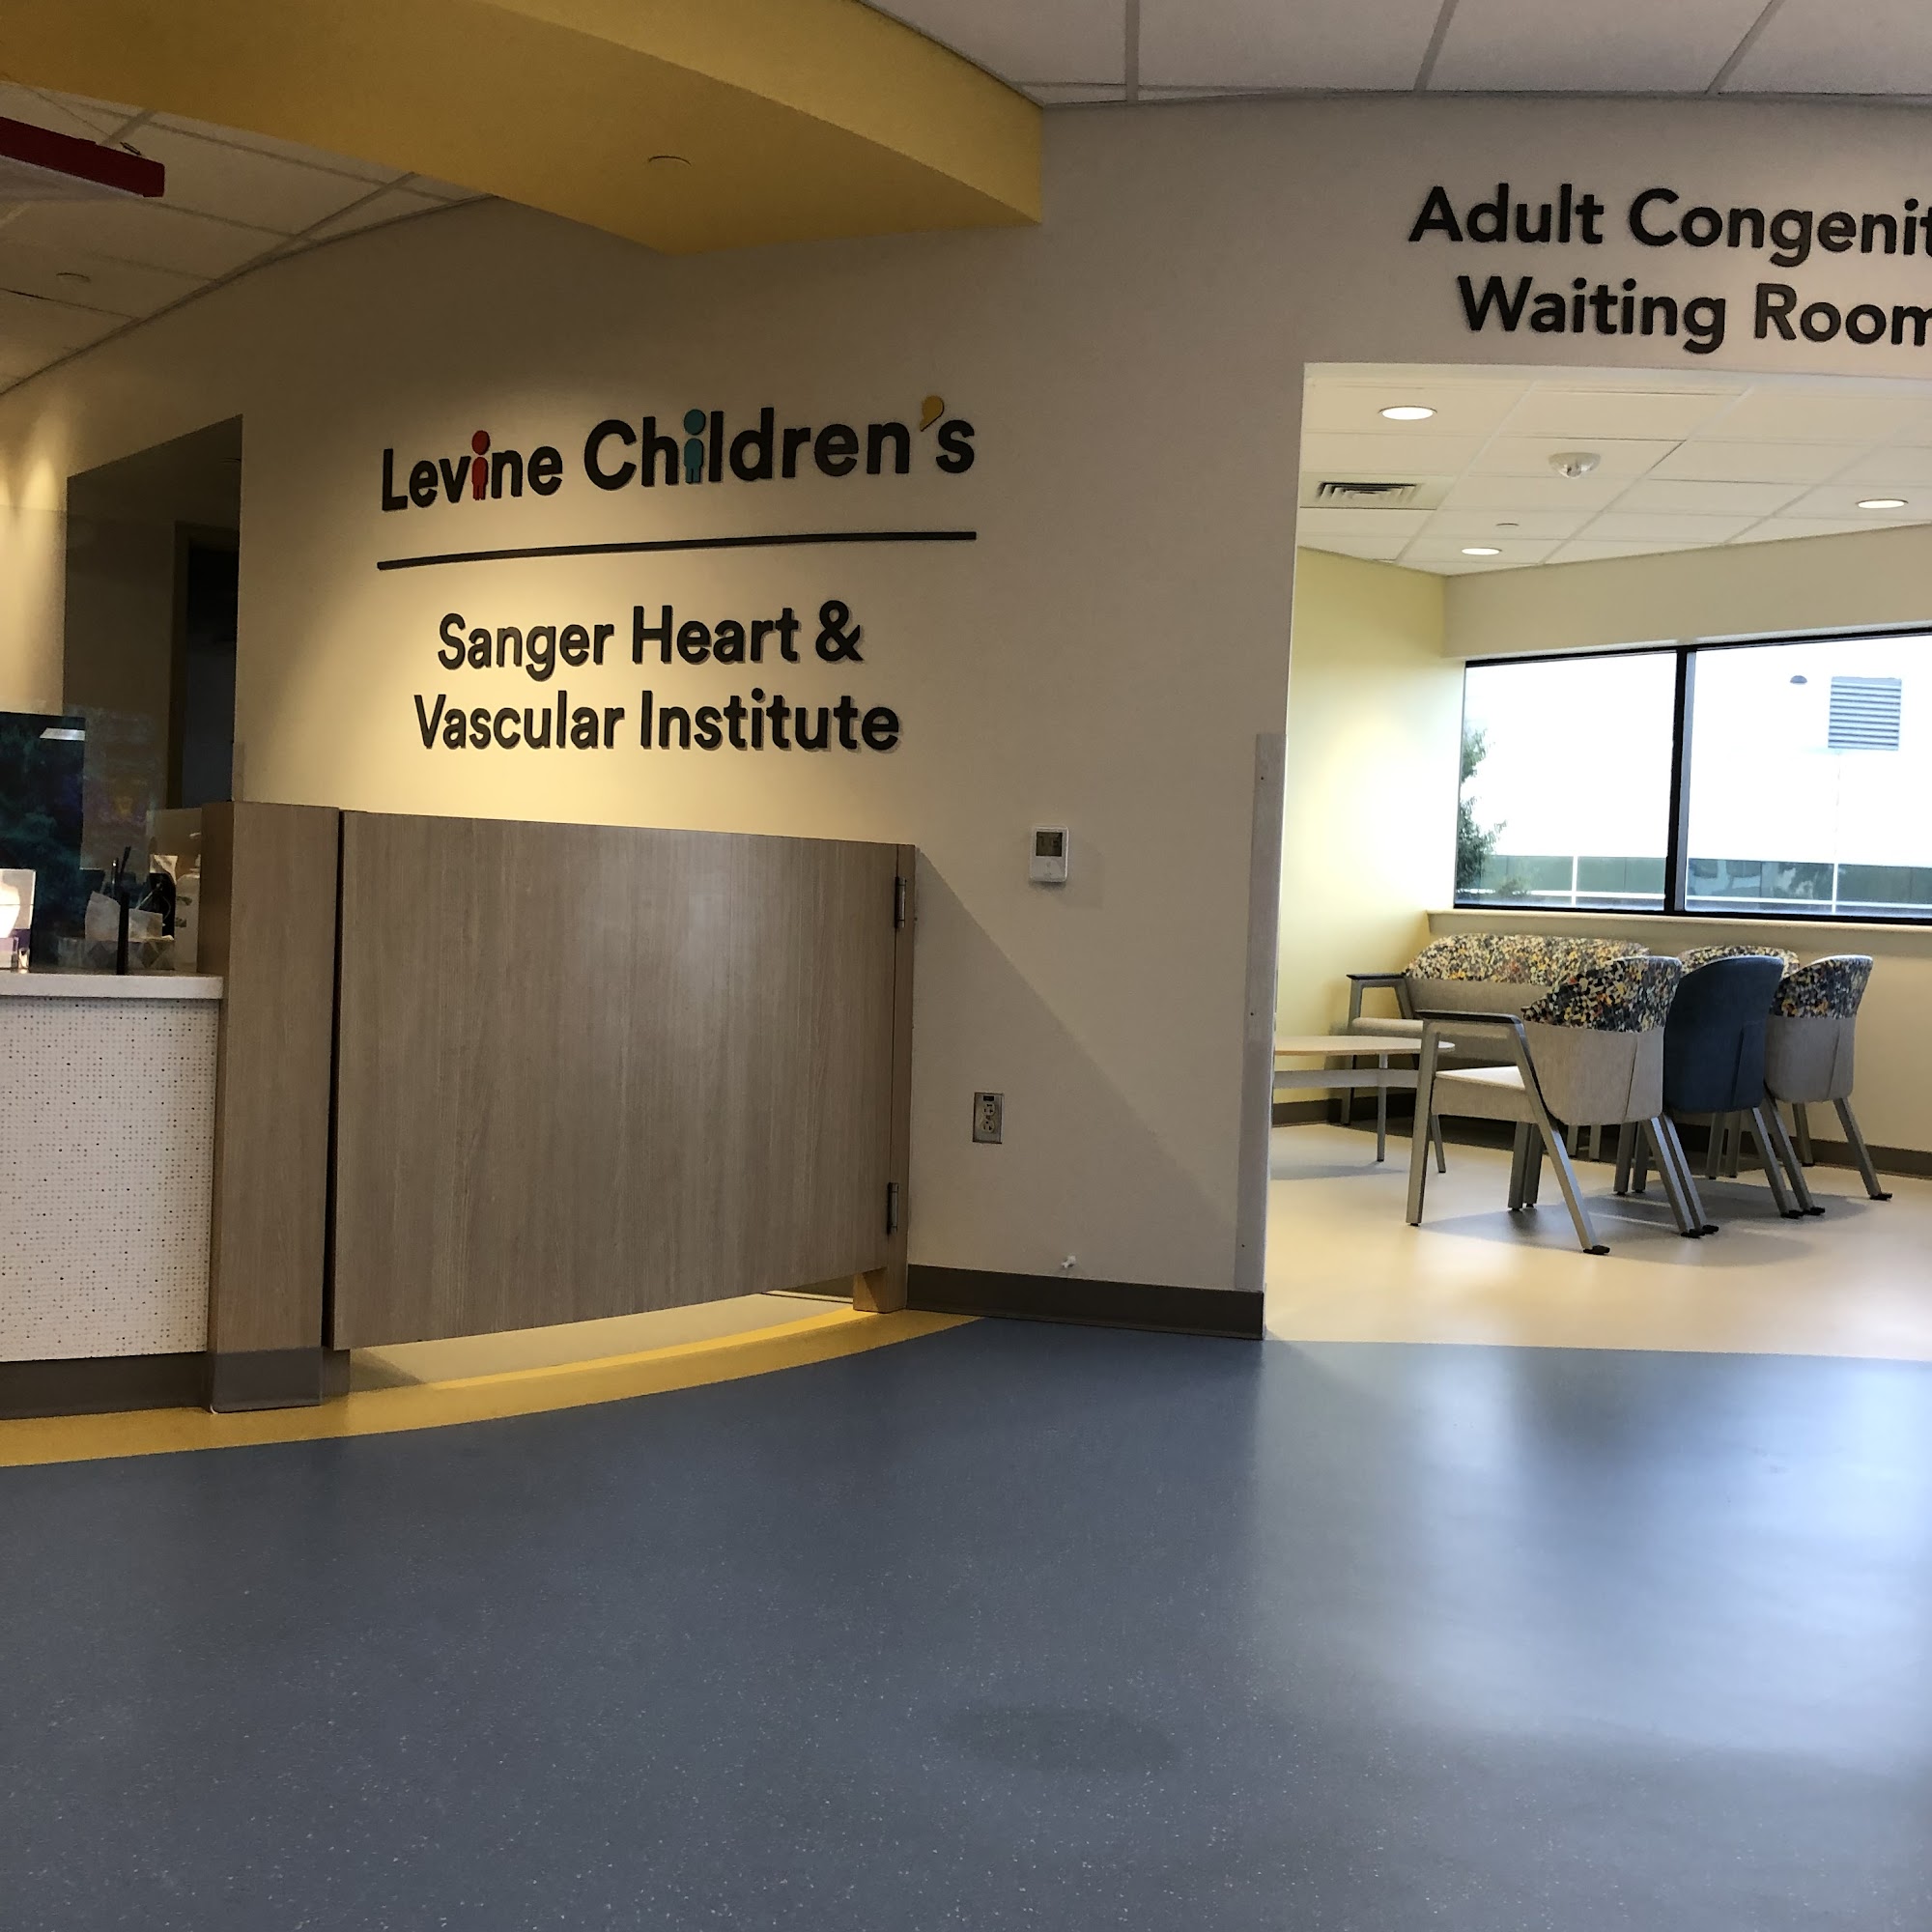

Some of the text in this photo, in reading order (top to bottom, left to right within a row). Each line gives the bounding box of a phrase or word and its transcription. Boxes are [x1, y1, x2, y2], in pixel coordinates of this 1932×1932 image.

[1408, 183, 1605, 244] Adult
[1458, 275, 1932, 355] Waiting Room
[382, 395, 976, 511] Levine Children's
[438, 600, 864, 681] Sanger Heart &
[414, 688, 899, 751] Vascular Institute
